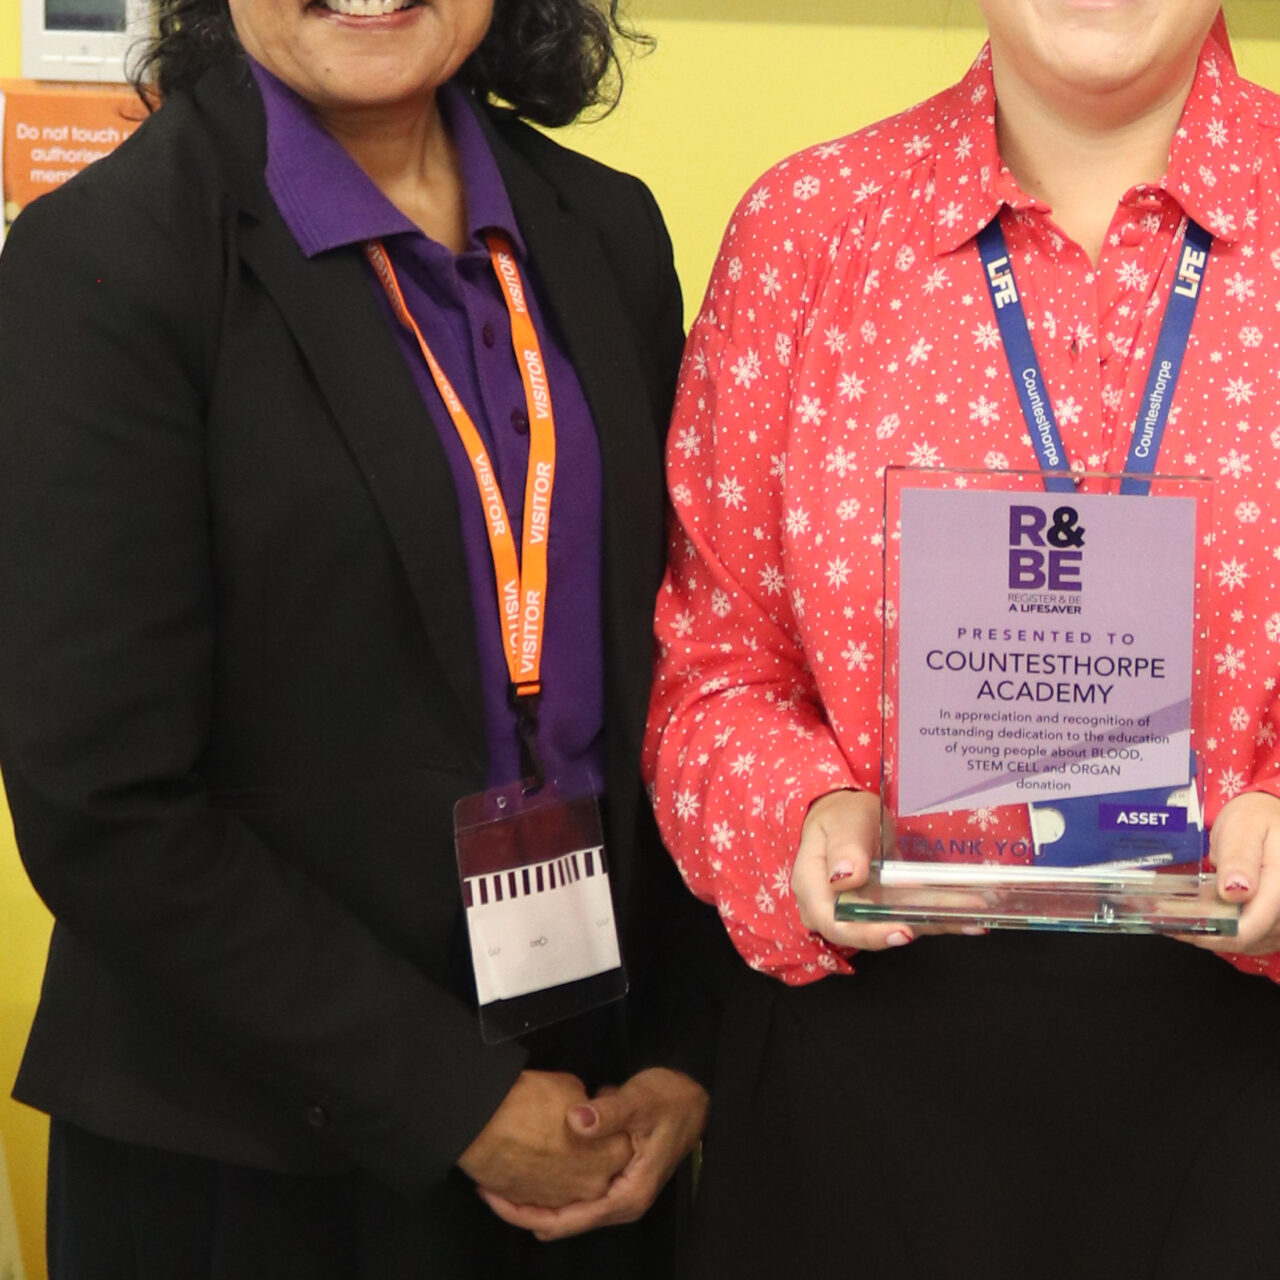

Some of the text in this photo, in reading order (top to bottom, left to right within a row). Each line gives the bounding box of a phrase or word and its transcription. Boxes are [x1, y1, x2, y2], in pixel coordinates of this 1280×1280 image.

[16, 122, 39, 140] Do
[42, 125, 69, 142] not
[71, 126, 120, 143] touch
[497, 251, 526, 314] VISITOR
[523, 348, 550, 421] VISITOR
[1021, 367, 1060, 467] Countesthorpe
[1134, 360, 1173, 458] Countesthorpe
[473, 452, 507, 537] VISITOR
[529, 461, 552, 545] VISITOR
[1009, 504, 1086, 549] R&
[1008, 549, 1083, 592] BE
[1008, 593, 1082, 605] REGISTER & BE
[1008, 604, 1082, 615] A LIFESAVER
[520, 590, 541, 674] VISITOR
[957, 626, 1136, 646] PRESENTED TO
[926, 649, 1166, 680] COUNTESTHORPE
[976, 679, 1114, 705] ACADEMY
[939, 708, 1151, 729] In appreciation and recognition of
[919, 725, 1170, 745] outstanding dedication to the education
[944, 742, 1144, 763] of young people about BLOOD,
[967, 759, 1121, 777] STEM CELL and ORGAN
[1016, 777, 1072, 792] donation
[1116, 811, 1170, 827] ASSET
